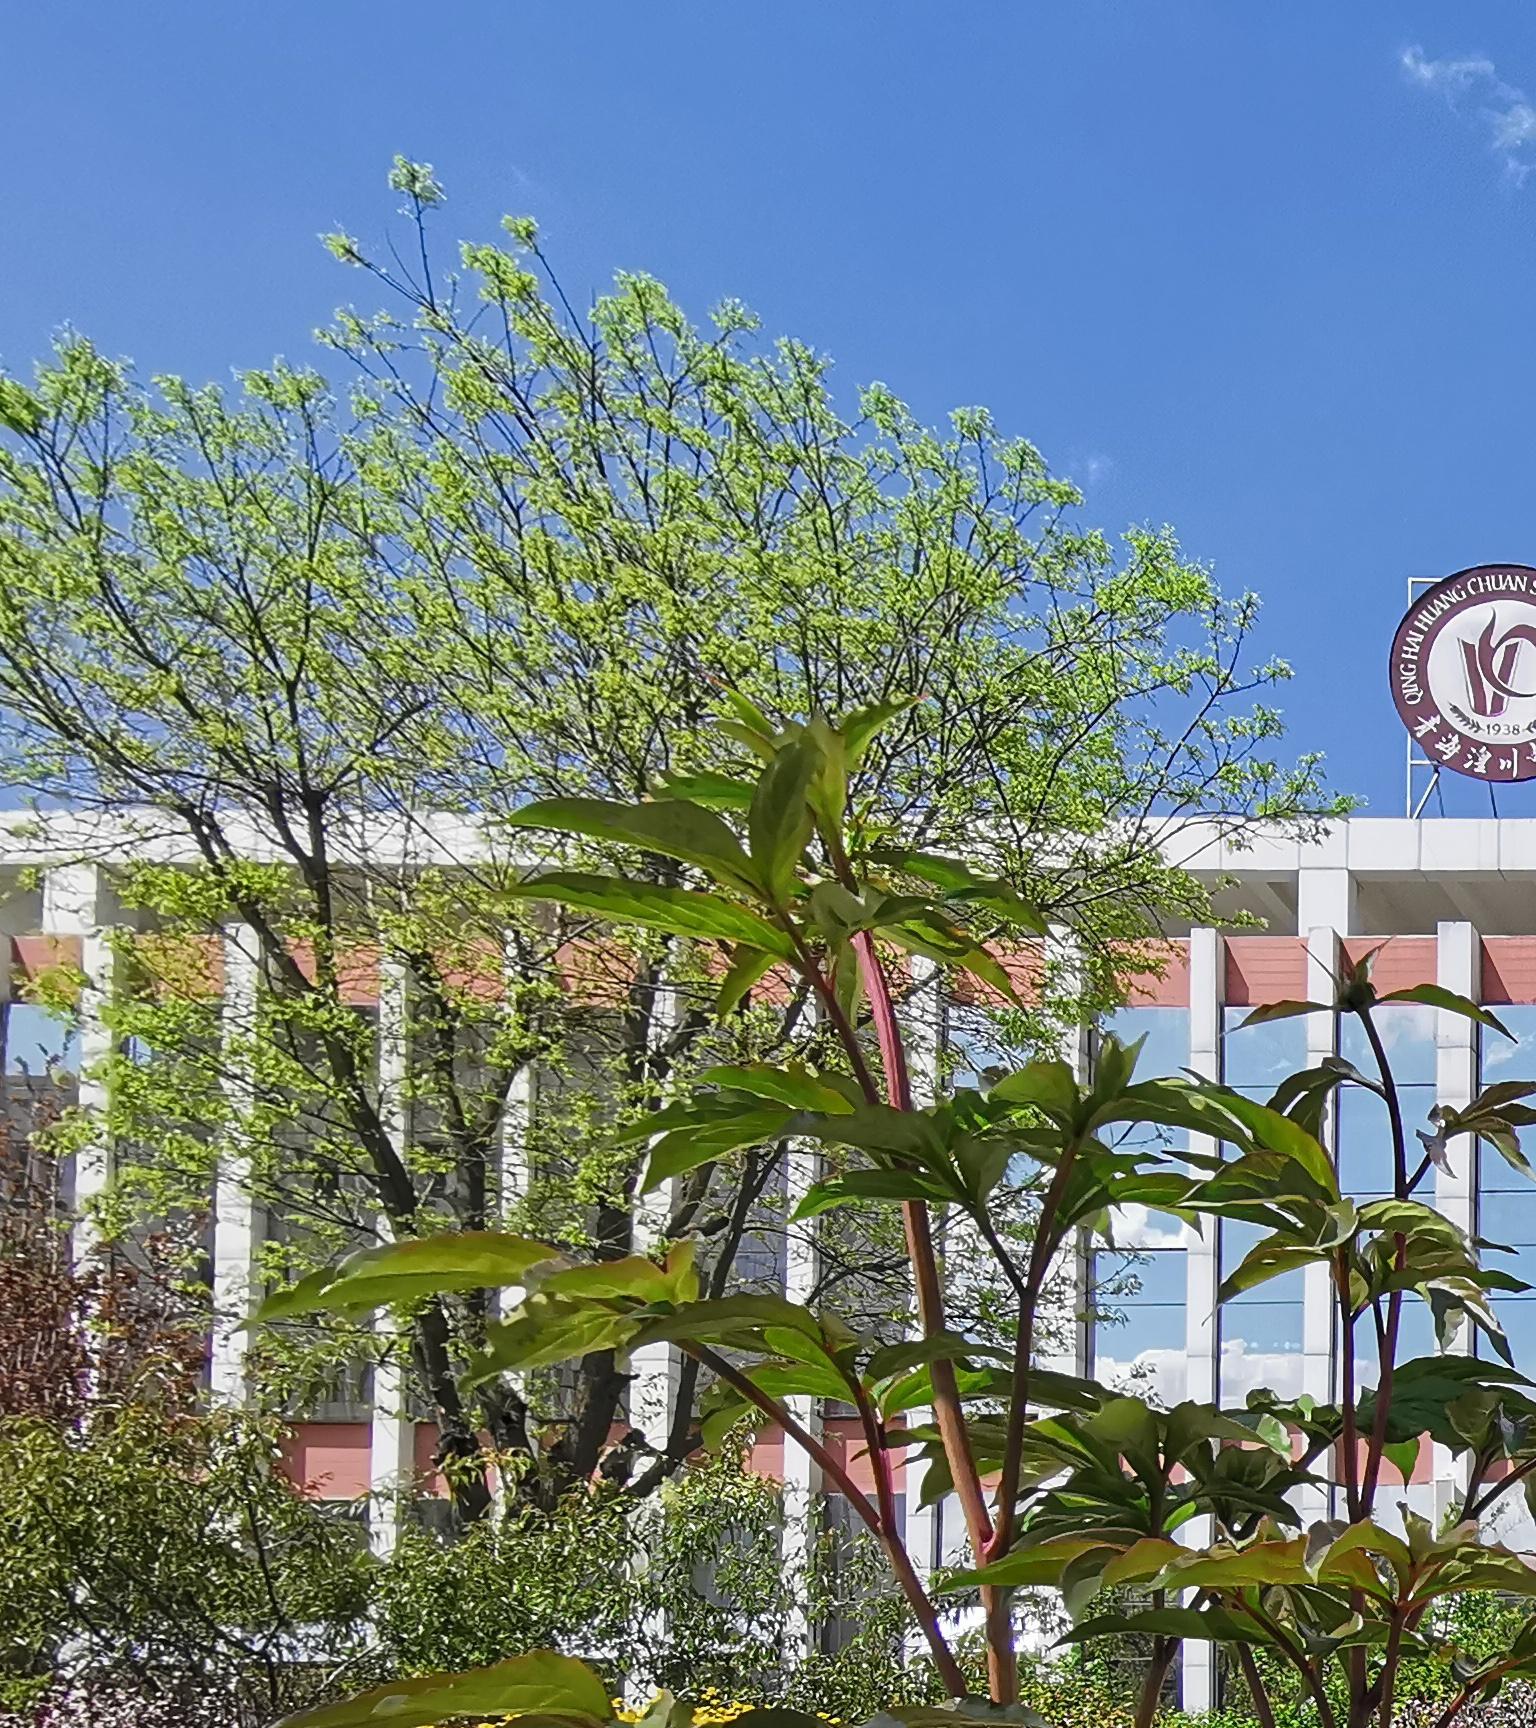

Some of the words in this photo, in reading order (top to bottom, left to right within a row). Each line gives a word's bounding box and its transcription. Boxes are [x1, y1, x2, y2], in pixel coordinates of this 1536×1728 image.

[1467, 574, 1528, 595] CHUAN
[1416, 586, 1466, 632] HUANG
[1401, 631, 1425, 661] HAI
[1400, 664, 1424, 705] QING
[1486, 723, 1521, 736] 1938
